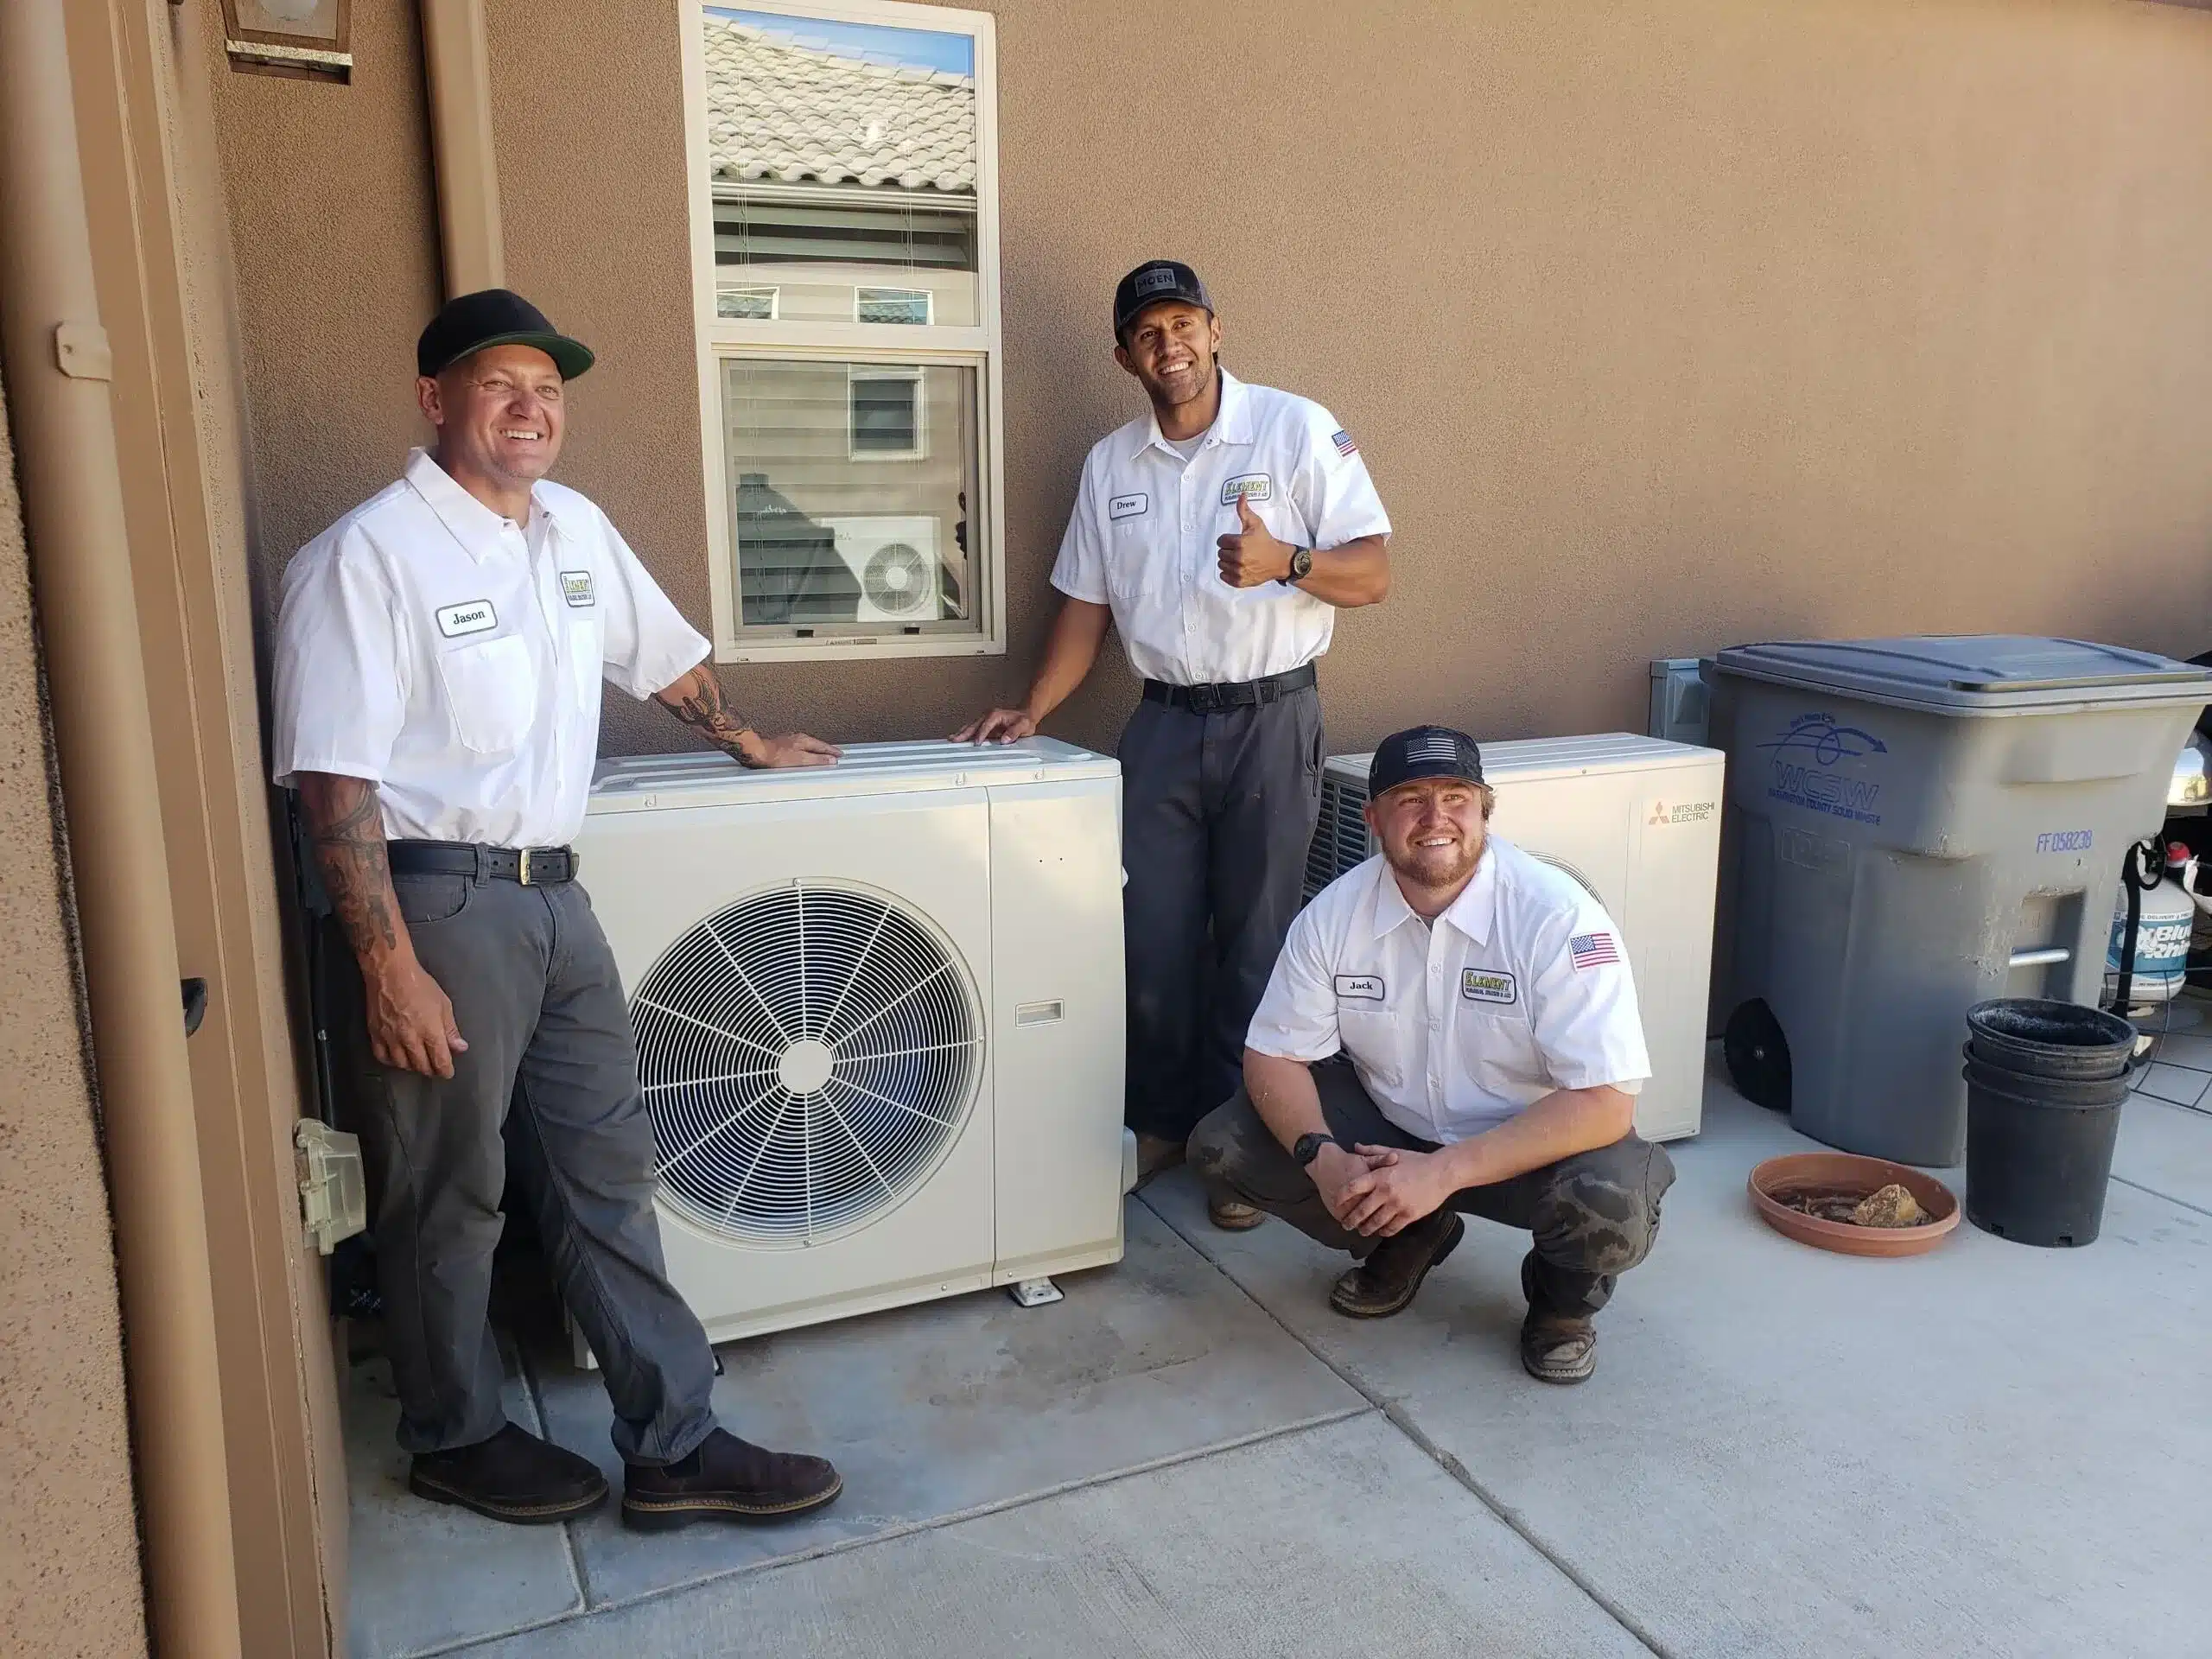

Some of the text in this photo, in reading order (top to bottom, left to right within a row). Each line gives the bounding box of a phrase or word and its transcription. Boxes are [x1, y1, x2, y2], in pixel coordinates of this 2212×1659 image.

[1137, 274, 1173, 289] MOEN
[1116, 499, 1137, 510] Drew
[453, 610, 486, 625] Jason
[1775, 760, 1880, 810] WCSW
[1672, 802, 1715, 815] MITSUBISHI
[1671, 811, 1709, 823] ELECTRIC
[2156, 925, 2192, 942] Blu
[1349, 981, 1374, 990] Jack
[1465, 971, 1512, 991] ELEMENT
